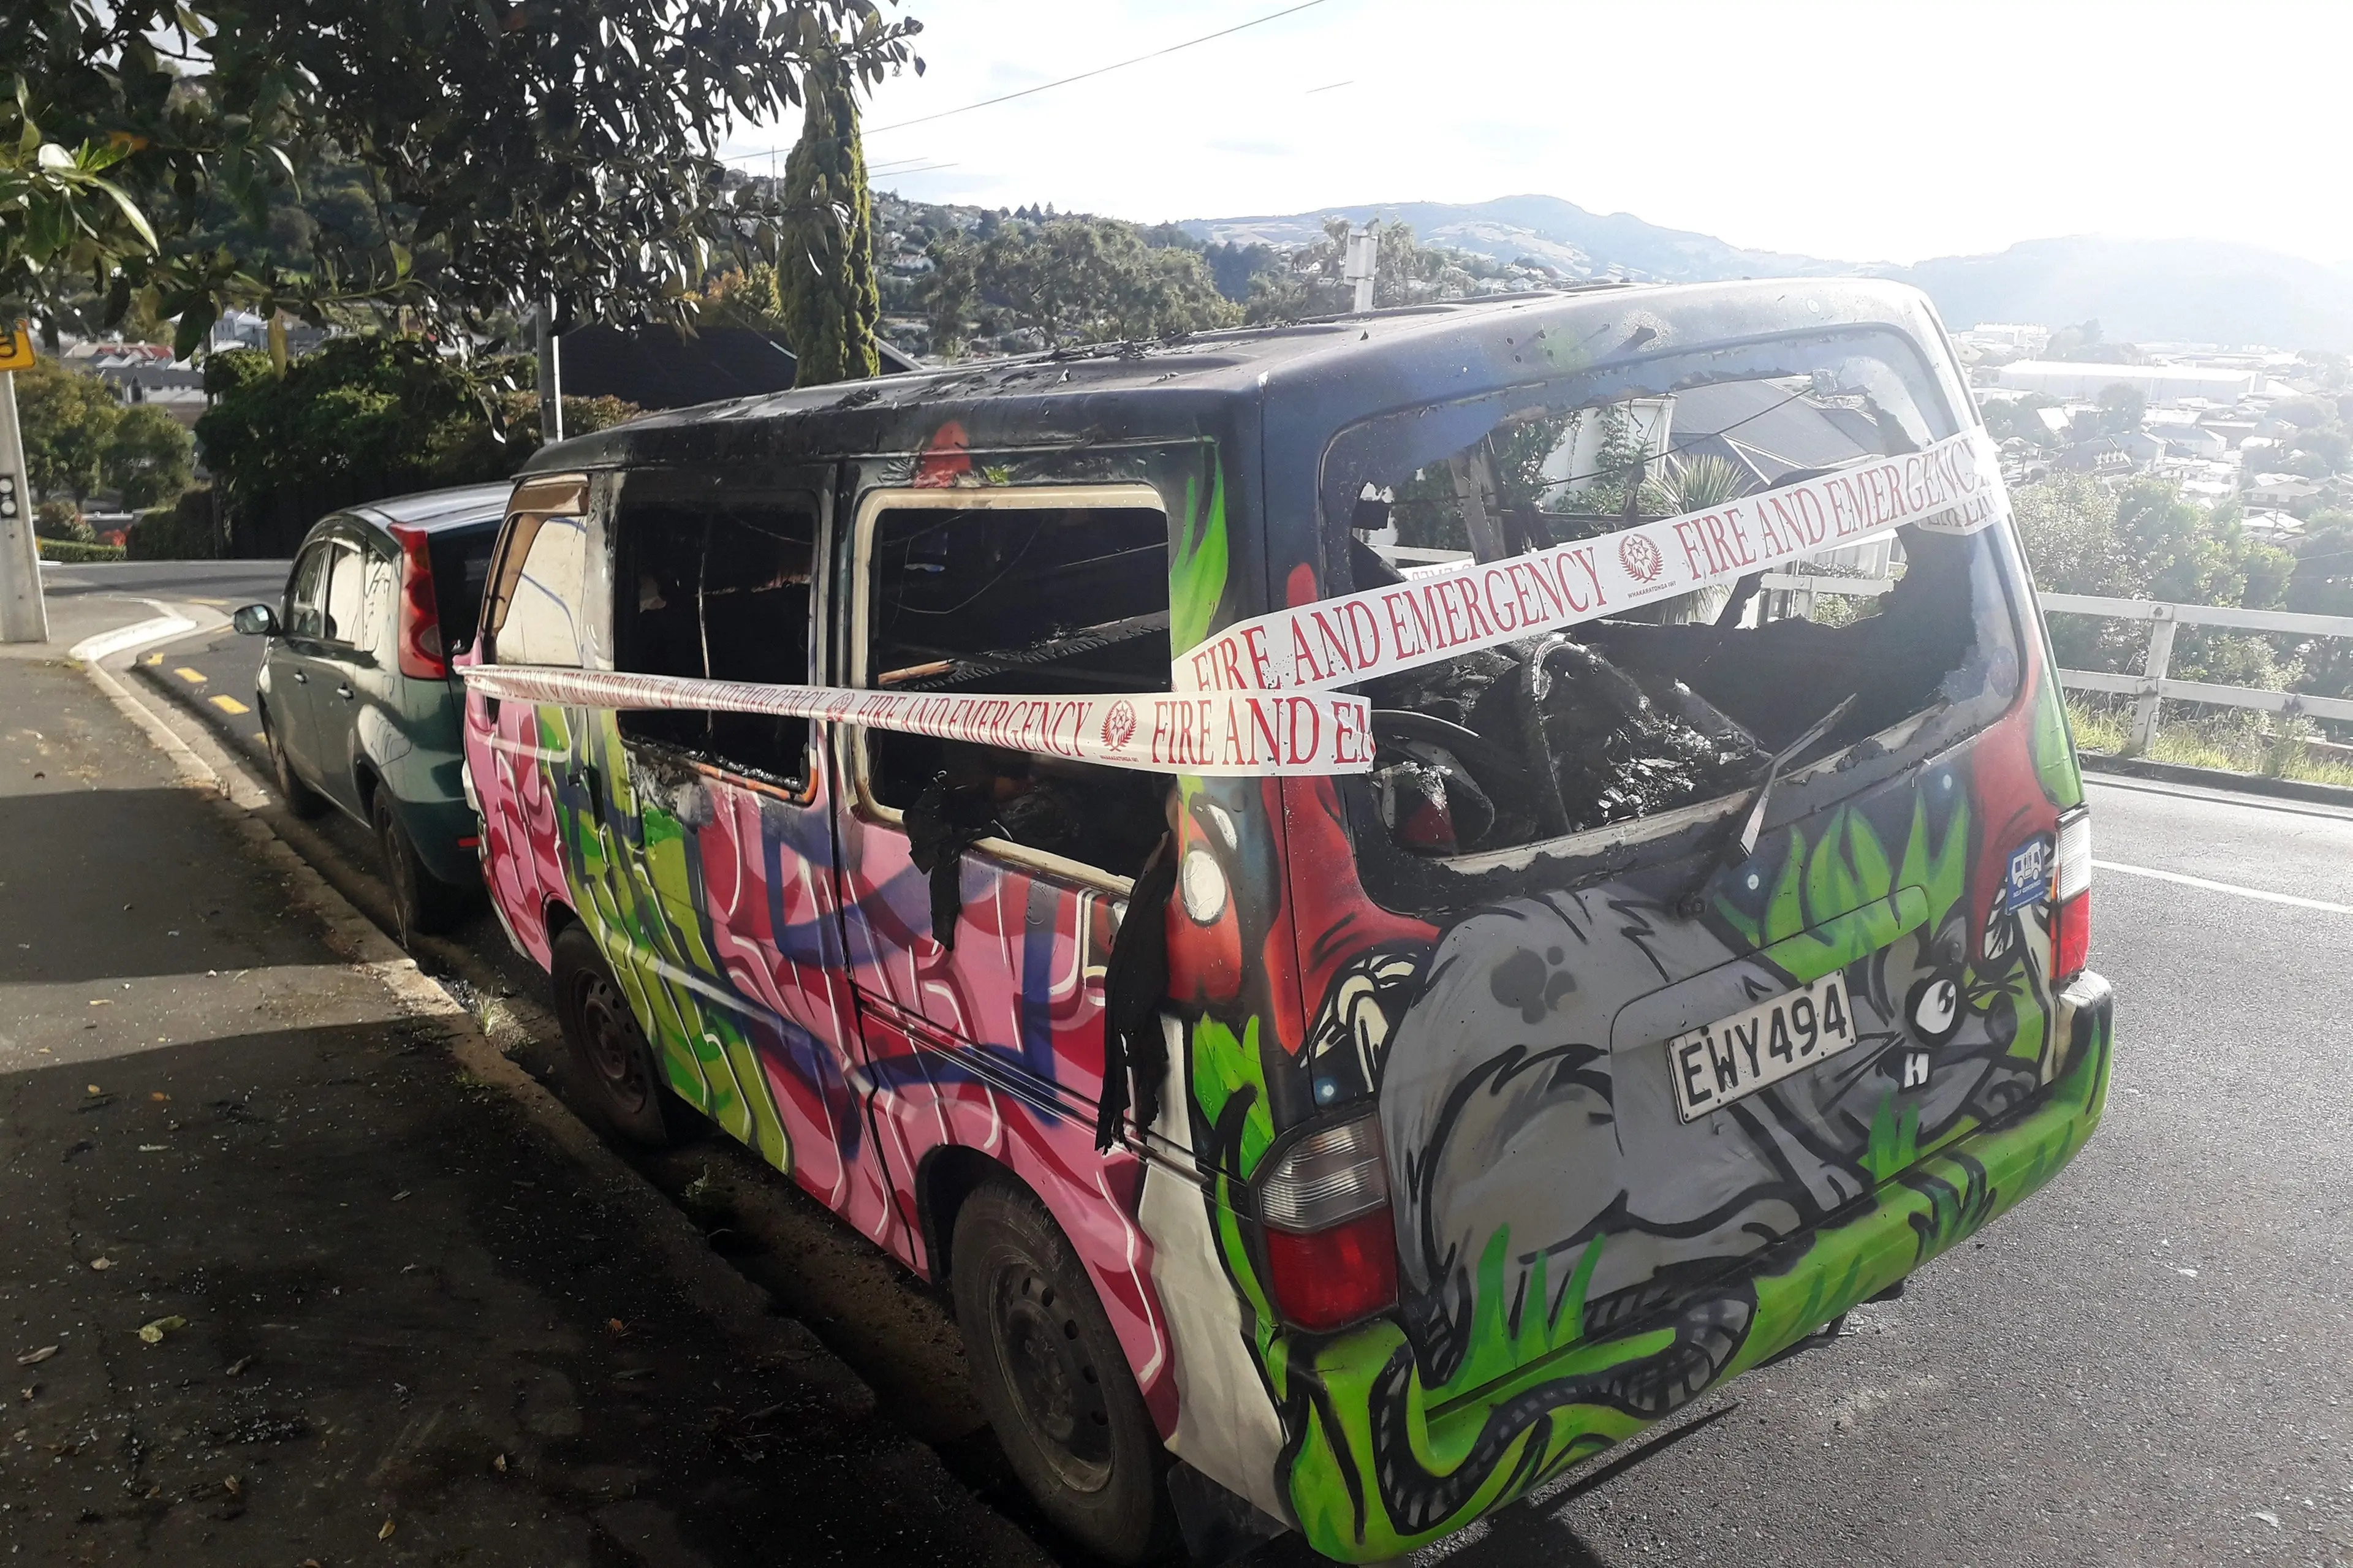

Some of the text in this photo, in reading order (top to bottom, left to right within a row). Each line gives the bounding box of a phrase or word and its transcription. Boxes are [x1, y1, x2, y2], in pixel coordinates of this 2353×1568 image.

[1673, 511, 1758, 581] FIRE
[1754, 487, 1826, 560] AND
[1192, 546, 1607, 691] FIRE AND EMERGENCY
[857, 694, 1093, 757] FIRE AND EMERGENCY
[1151, 699, 1213, 765] FIRE
[1222, 697, 1320, 765] AND
[1680, 984, 1846, 1106] EWY494
